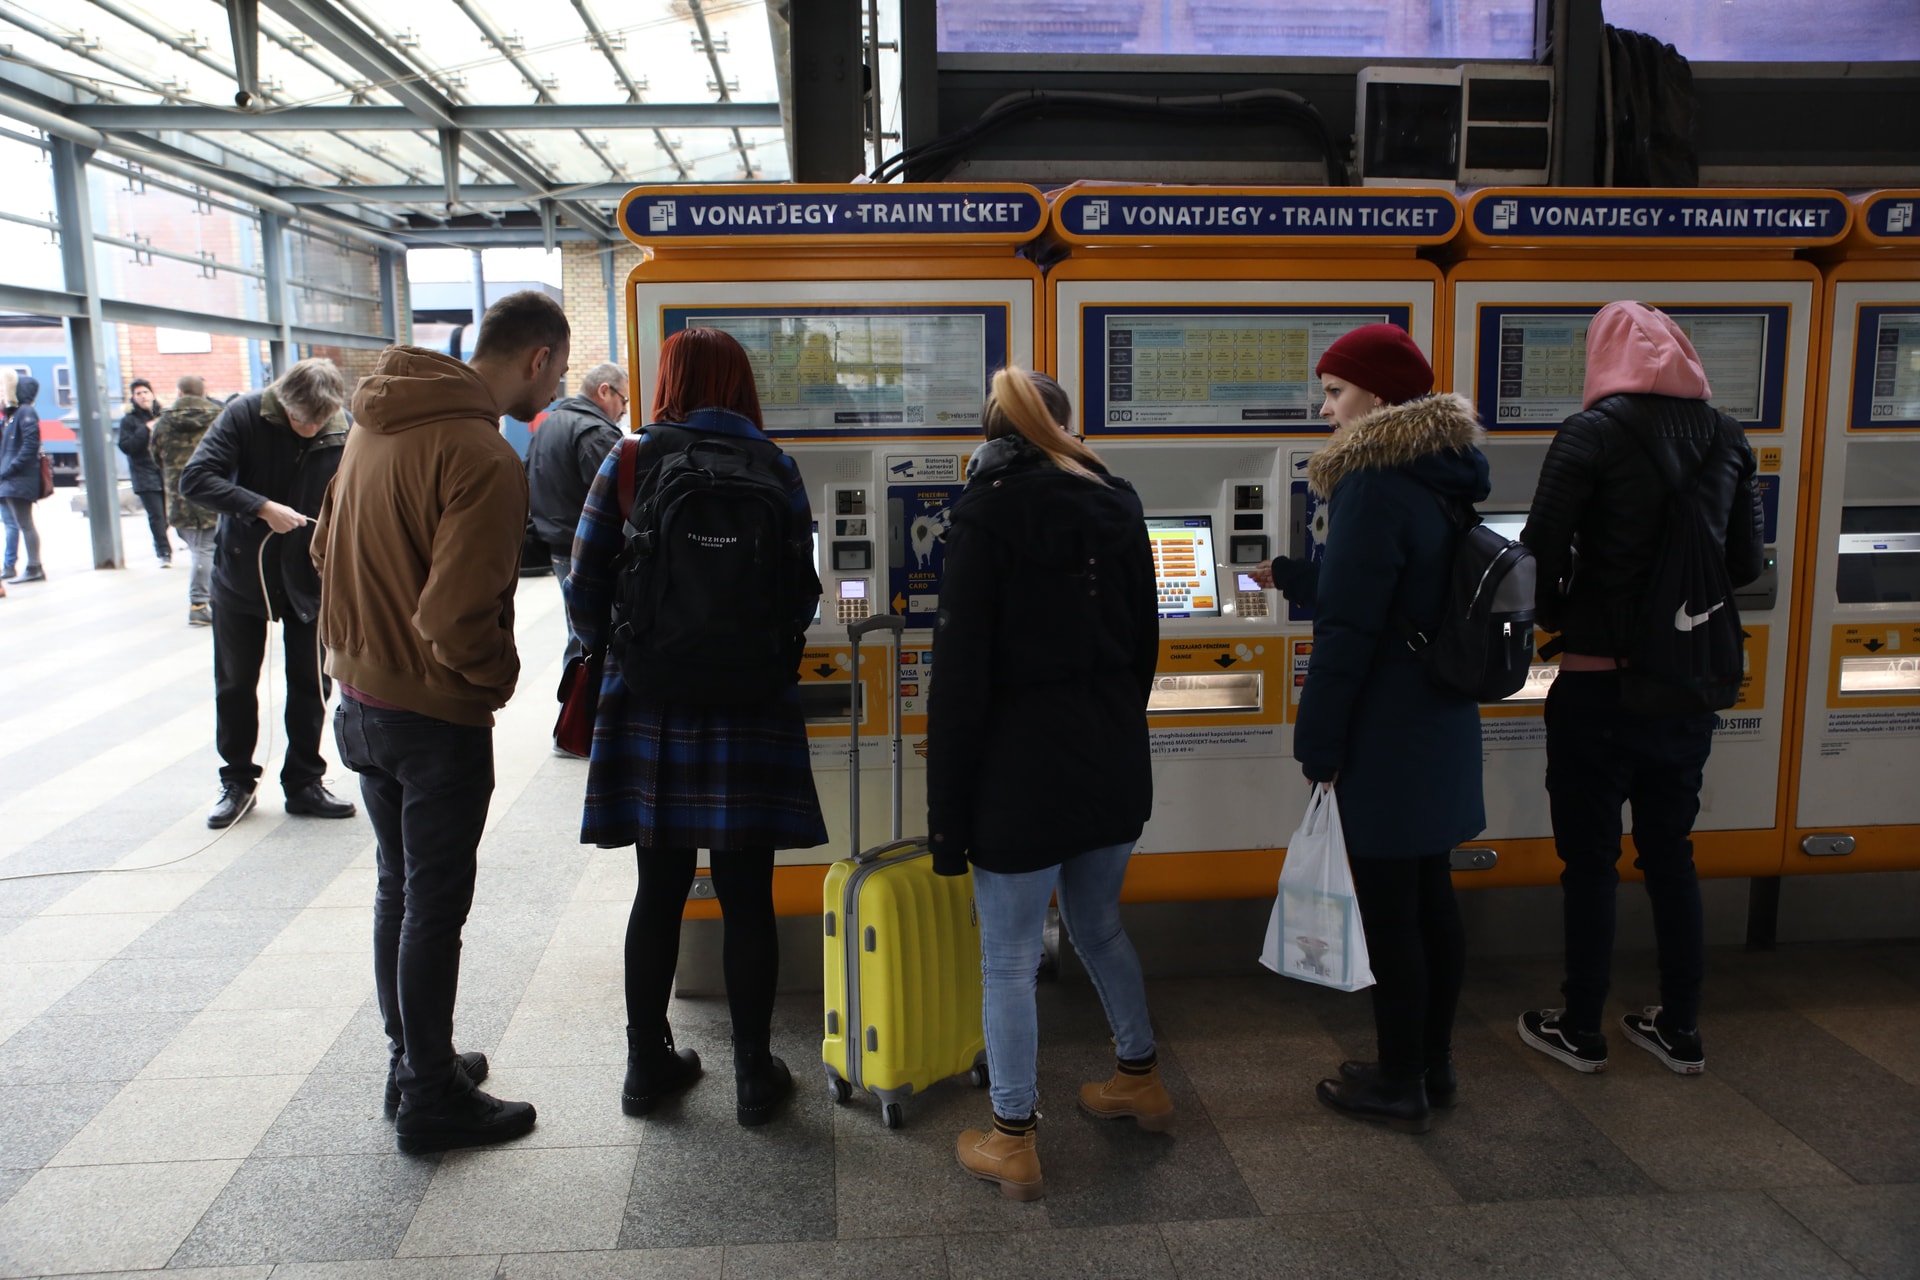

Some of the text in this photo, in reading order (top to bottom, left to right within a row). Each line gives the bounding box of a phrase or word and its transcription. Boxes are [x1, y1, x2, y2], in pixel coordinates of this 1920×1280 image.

[690, 203, 1023, 226] VONATJEGY TRAIN TICKET
[1122, 206, 1438, 227] VONATJEGY TRAIN TICKET
[1530, 207, 1830, 227] VONATJEGY TRAIN TICKET
[687, 532, 738, 544] PRINZHORN
[901, 669, 917, 677] VISA
